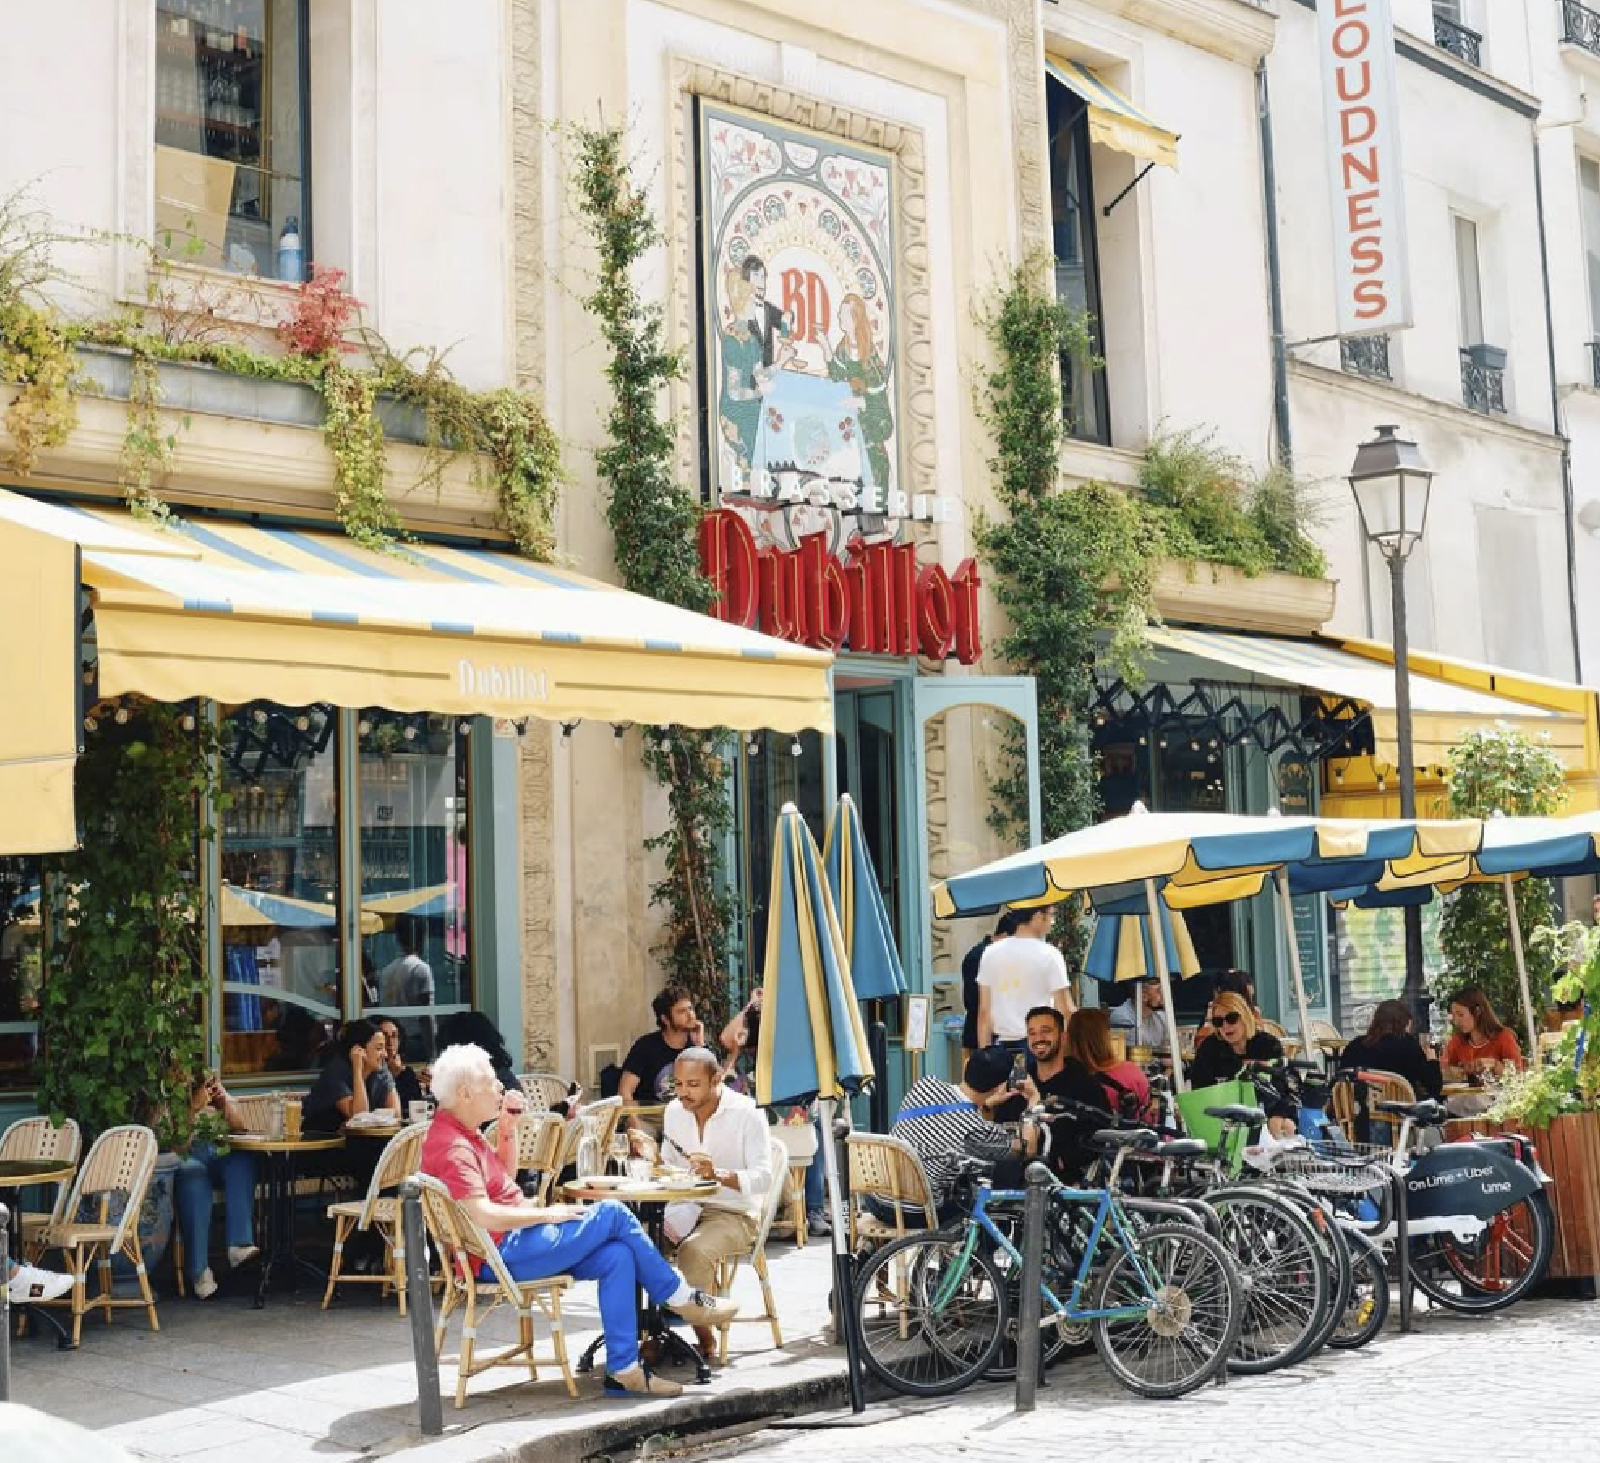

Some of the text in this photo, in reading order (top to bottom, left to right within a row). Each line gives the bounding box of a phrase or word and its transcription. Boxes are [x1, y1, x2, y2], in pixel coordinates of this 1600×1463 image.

[725, 466, 960, 520] BRASSERIE
[698, 507, 982, 664] Dubillot
[1408, 1180, 1427, 1192] On
[1426, 1174, 1454, 1188] Lime
[1463, 1165, 1494, 1179] Uber
[1481, 1181, 1512, 1194] Lime
